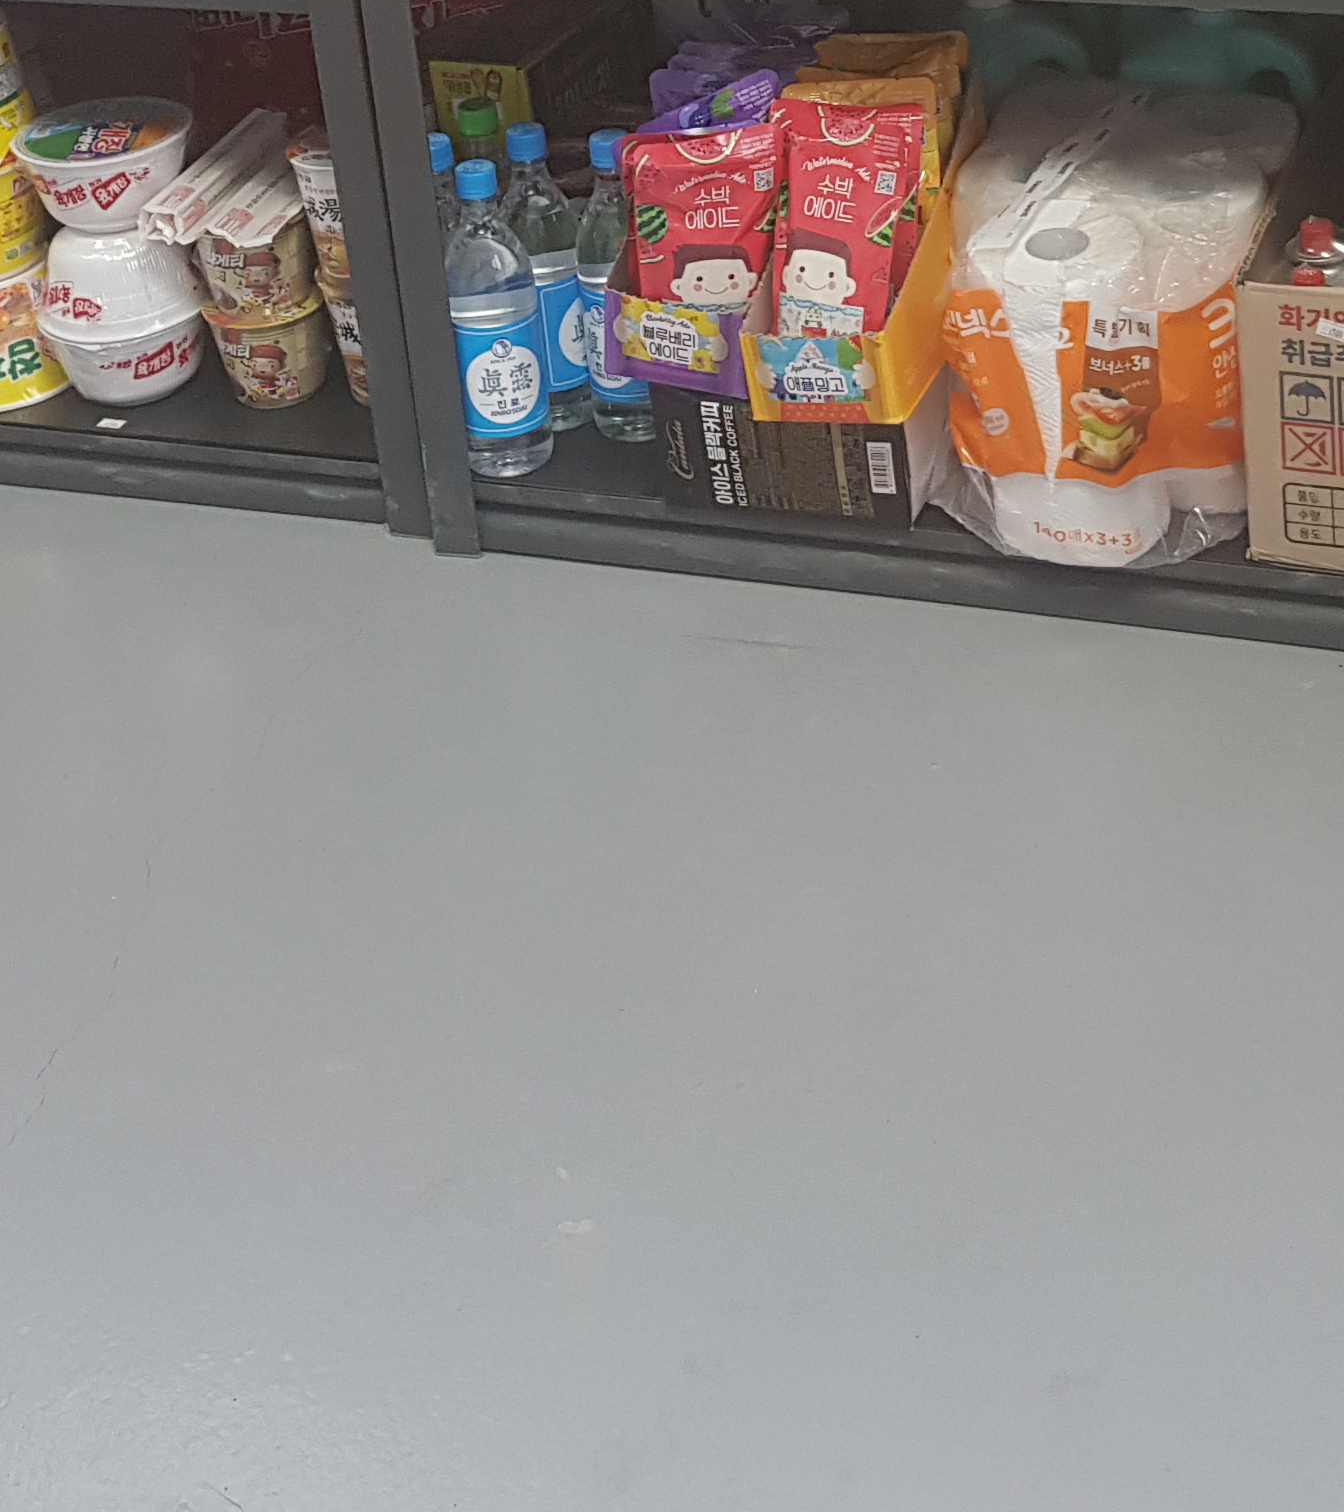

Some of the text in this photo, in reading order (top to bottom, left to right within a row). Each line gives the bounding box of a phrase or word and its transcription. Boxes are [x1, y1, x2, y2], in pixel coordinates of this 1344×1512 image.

[694, 185, 731, 207] 수박
[817, 173, 854, 199] 수박
[685, 207, 741, 230] 에이드
[803, 196, 857, 223] 에이드
[649, 344, 690, 364] 에이드
[700, 400, 735, 506] 아이스 블랙커피
[722, 404, 750, 507] ICED BLACK COFFEE
